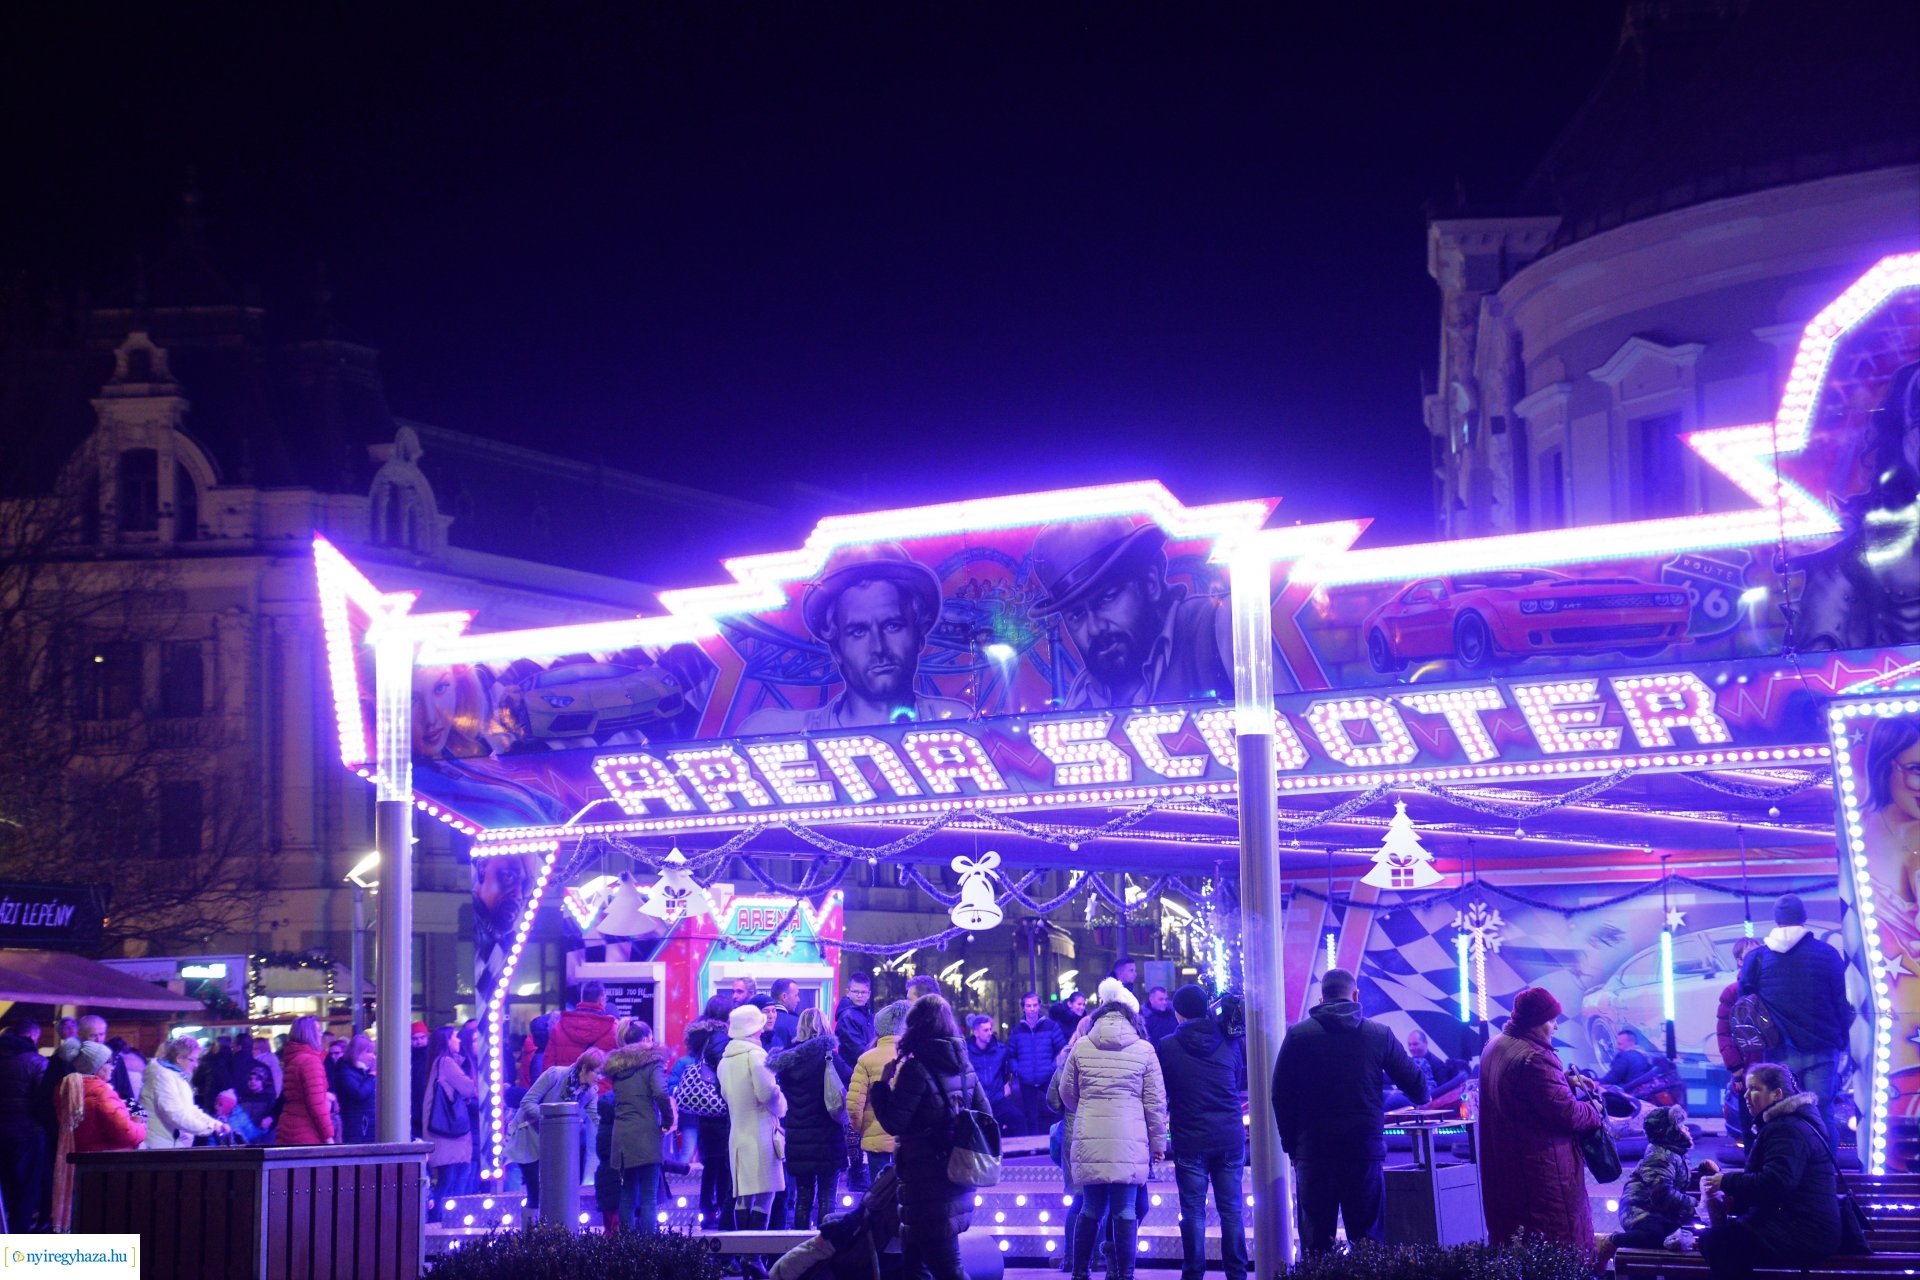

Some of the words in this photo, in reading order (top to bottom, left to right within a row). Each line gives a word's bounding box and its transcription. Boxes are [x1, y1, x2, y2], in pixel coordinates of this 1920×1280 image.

[1683, 558, 1734, 582] ROUTE
[592, 730, 1008, 815] ARENA
[1029, 671, 1732, 786] SCOOTER
[22, 898, 76, 927] LEPÉNY
